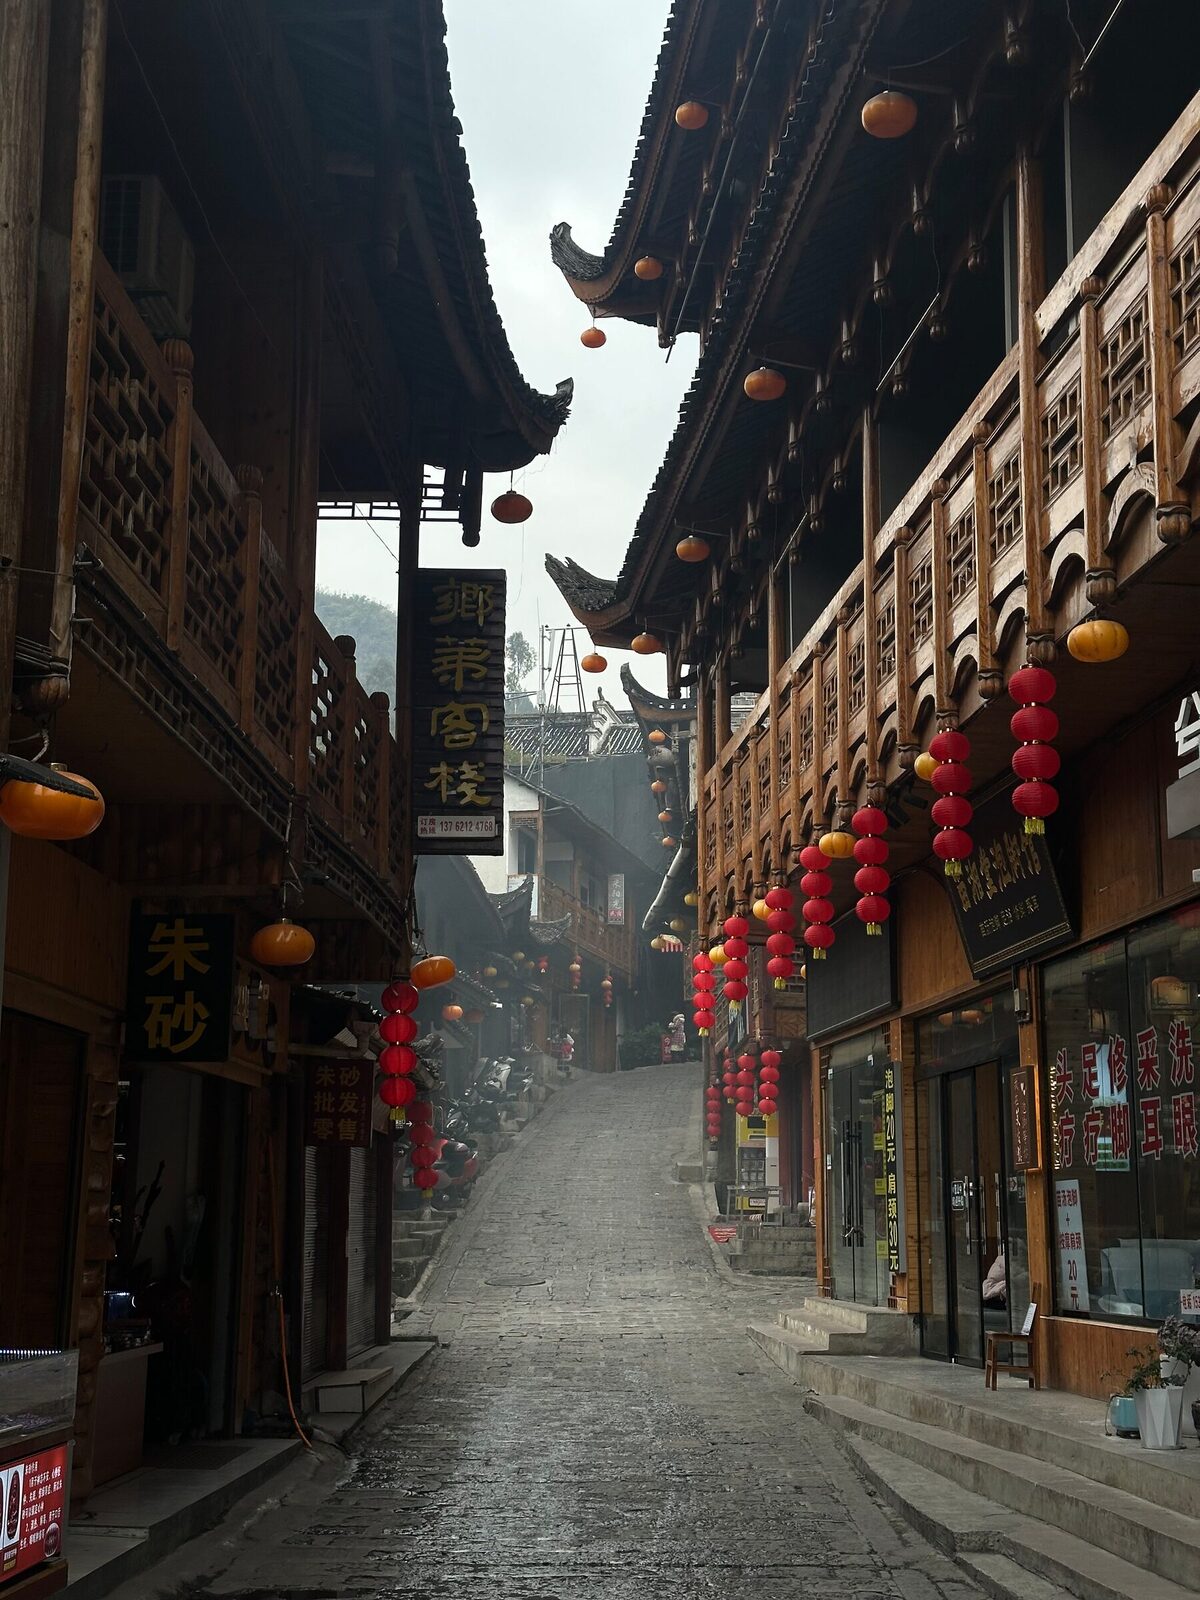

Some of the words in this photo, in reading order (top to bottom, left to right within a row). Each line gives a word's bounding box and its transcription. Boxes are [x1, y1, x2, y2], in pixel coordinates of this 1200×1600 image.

[440, 820, 453, 832] 137
[455, 820, 473, 832] 6212
[475, 820, 493, 832] 4768
[143, 918, 211, 1054] 朱砂
[314, 1064, 361, 1087] 朱砂
[313, 1091, 360, 1114] 批发
[312, 1117, 358, 1141] 零售
[1067, 1259, 1078, 1281] 20
[1070, 1286, 1080, 1310] 元
